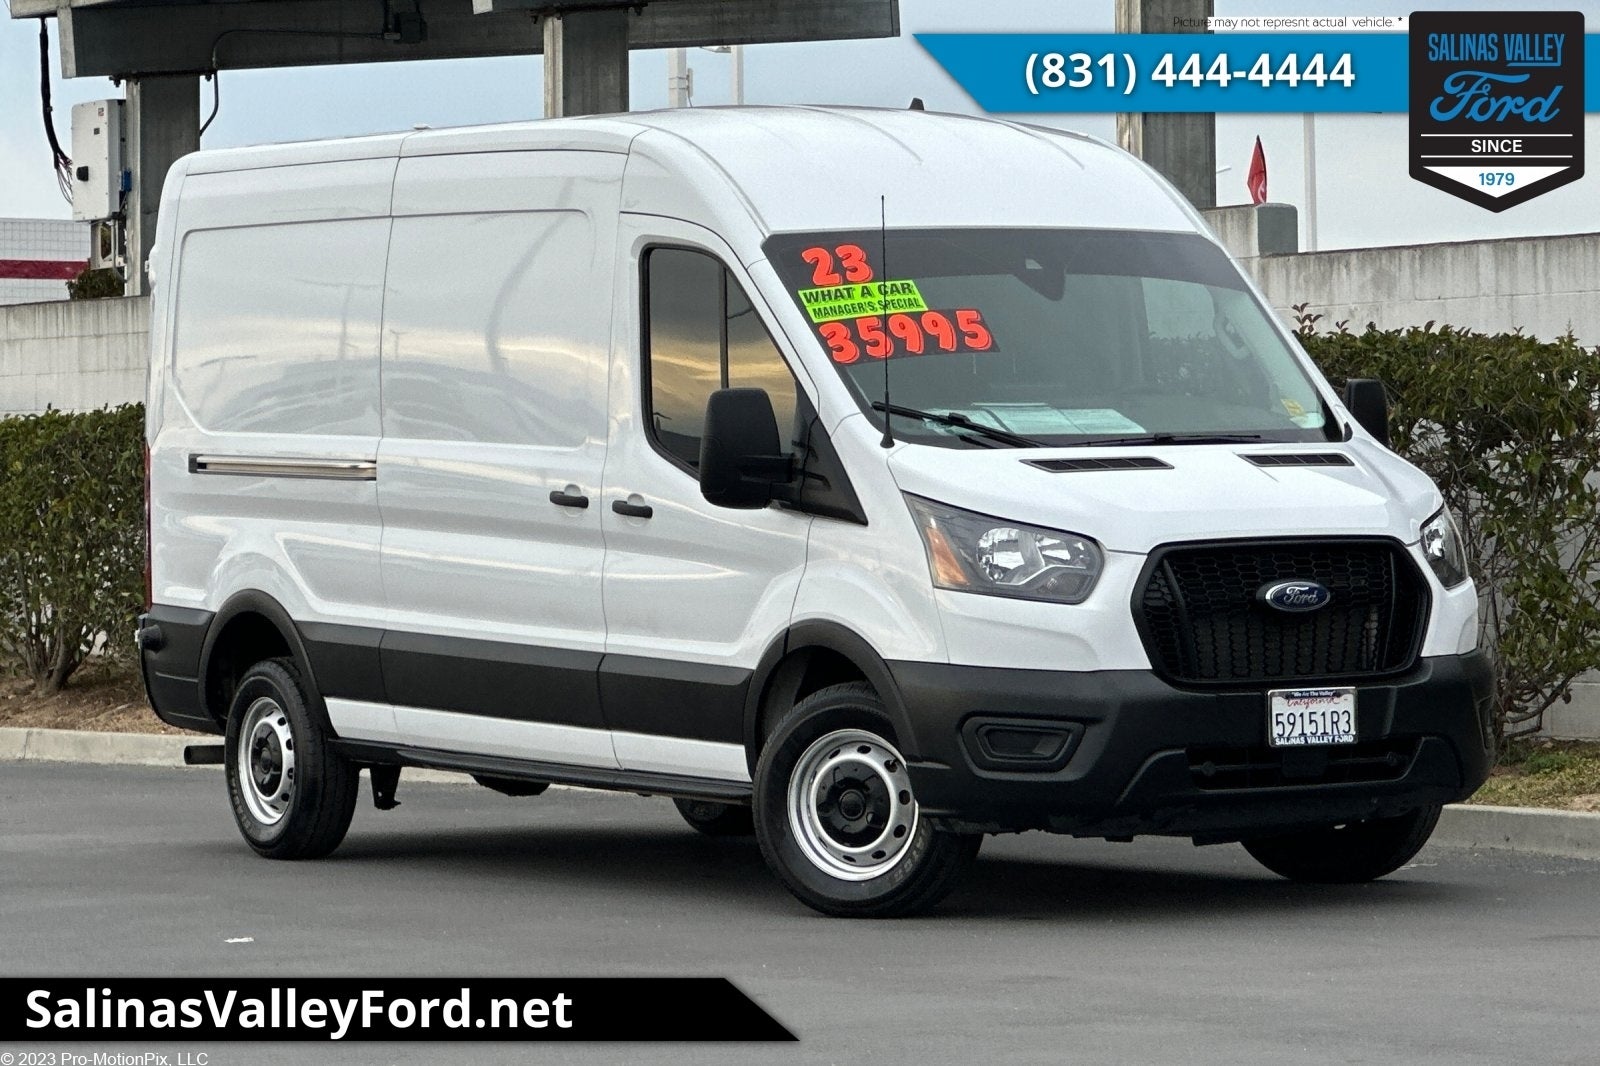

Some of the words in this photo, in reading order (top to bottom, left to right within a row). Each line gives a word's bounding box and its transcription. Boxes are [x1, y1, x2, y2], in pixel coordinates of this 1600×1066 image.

[802, 244, 873, 286] 23
[803, 286, 853, 304] WHAT
[860, 285, 873, 298] A
[877, 282, 913, 296] CAR
[813, 301, 876, 319] MANAGER'S
[878, 297, 921, 312] SPECIAL
[818, 309, 992, 363] 35995
[1284, 586, 1319, 604] Ford
[1275, 710, 1351, 737] 59151R3
[1275, 736, 1306, 746] SALINAS
[1307, 735, 1334, 744] VALLEY
[1335, 734, 1354, 743] FORD
